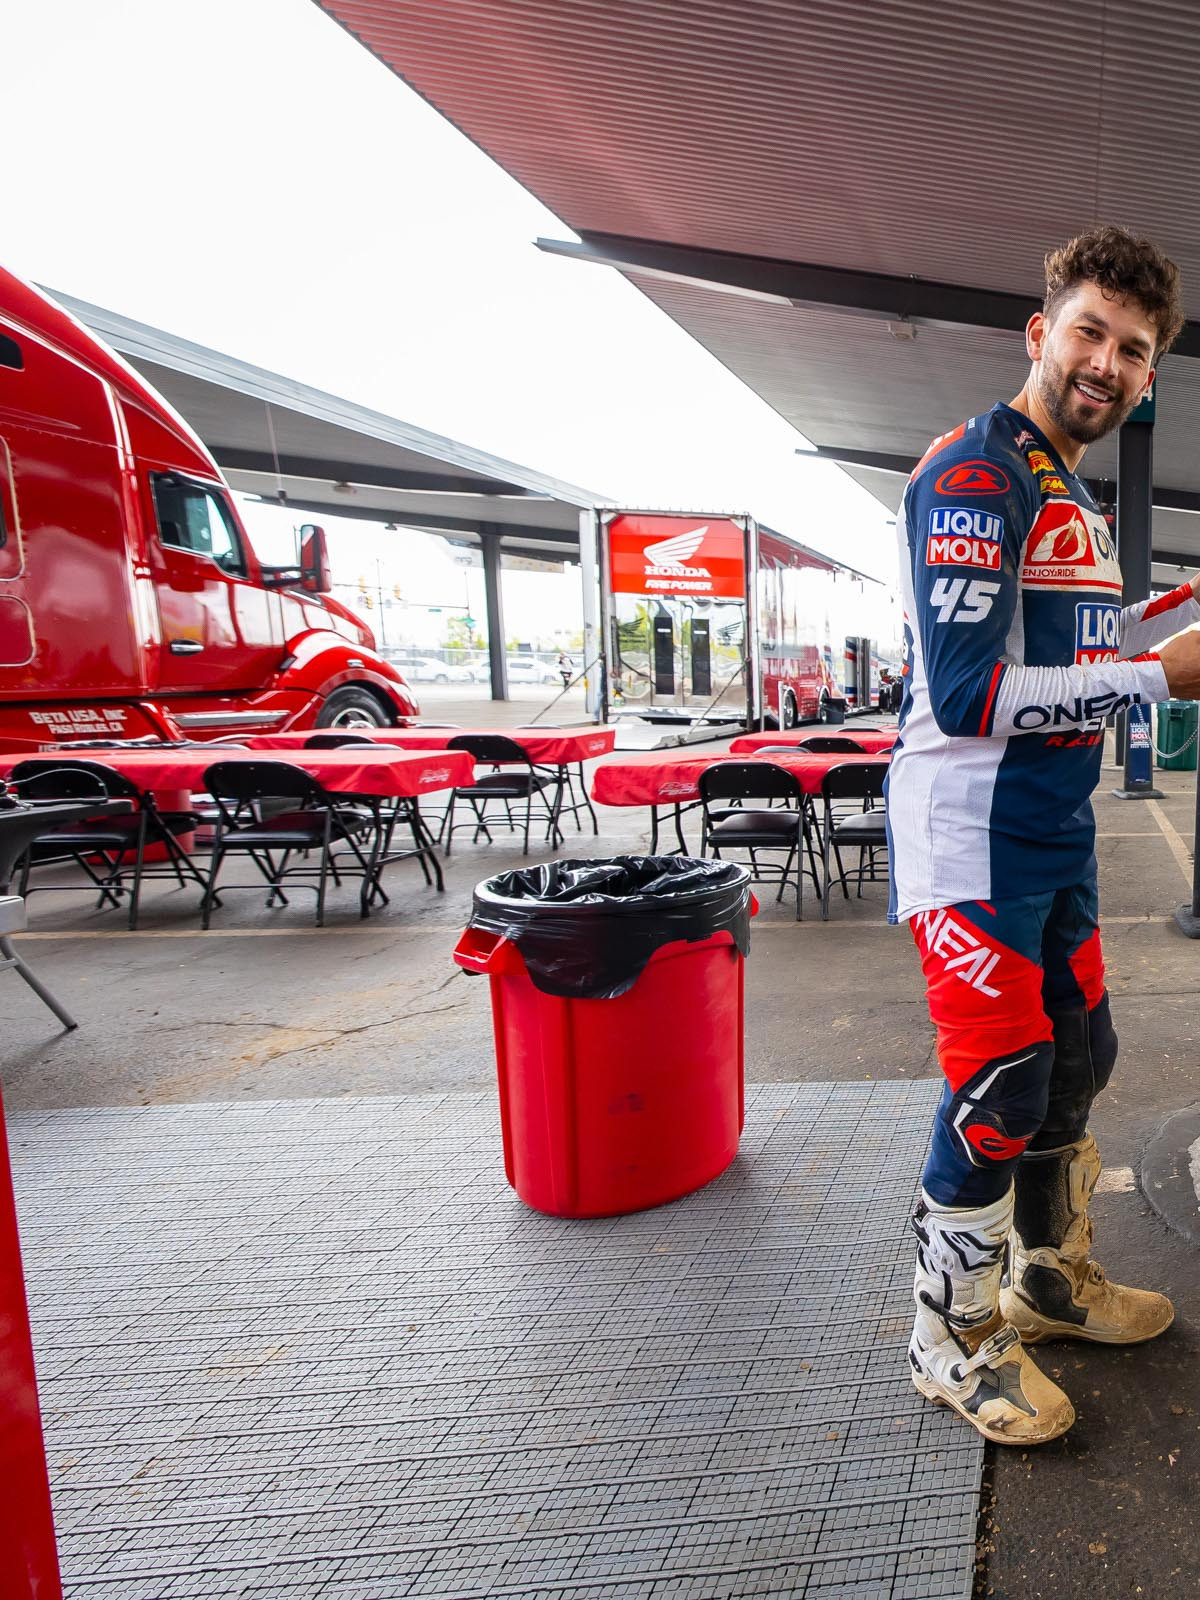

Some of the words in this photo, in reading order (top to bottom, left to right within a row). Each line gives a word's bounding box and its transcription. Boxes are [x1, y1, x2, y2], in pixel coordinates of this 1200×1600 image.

[932, 511, 1000, 541] LIQUI
[930, 539, 999, 566] MOLY
[644, 565, 712, 578] HONDA
[930, 578, 1001, 623] 45
[29, 711, 71, 724] BETA
